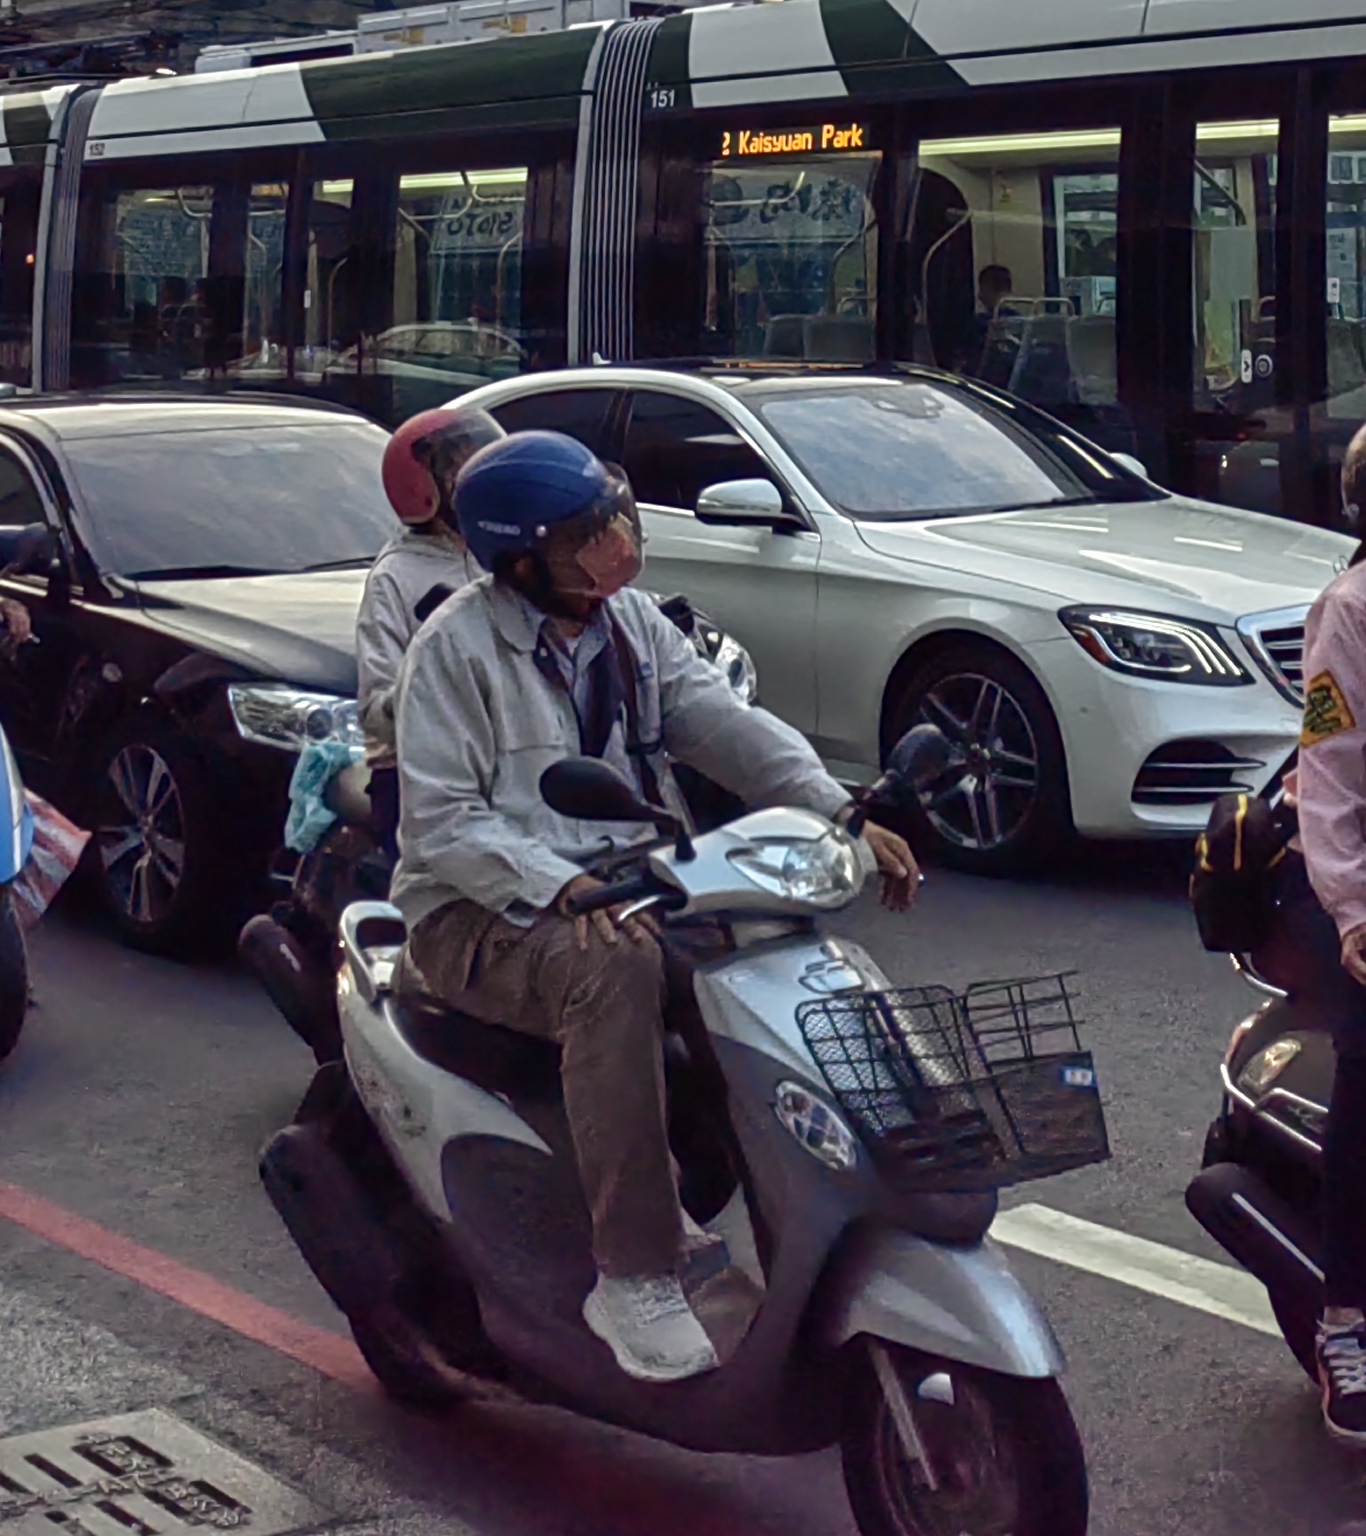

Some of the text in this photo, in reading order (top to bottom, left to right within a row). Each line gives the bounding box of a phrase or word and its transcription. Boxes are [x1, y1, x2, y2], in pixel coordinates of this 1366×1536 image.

[650, 89, 675, 109] 151
[738, 130, 813, 155] Kaisyuan
[821, 123, 863, 149] Park
